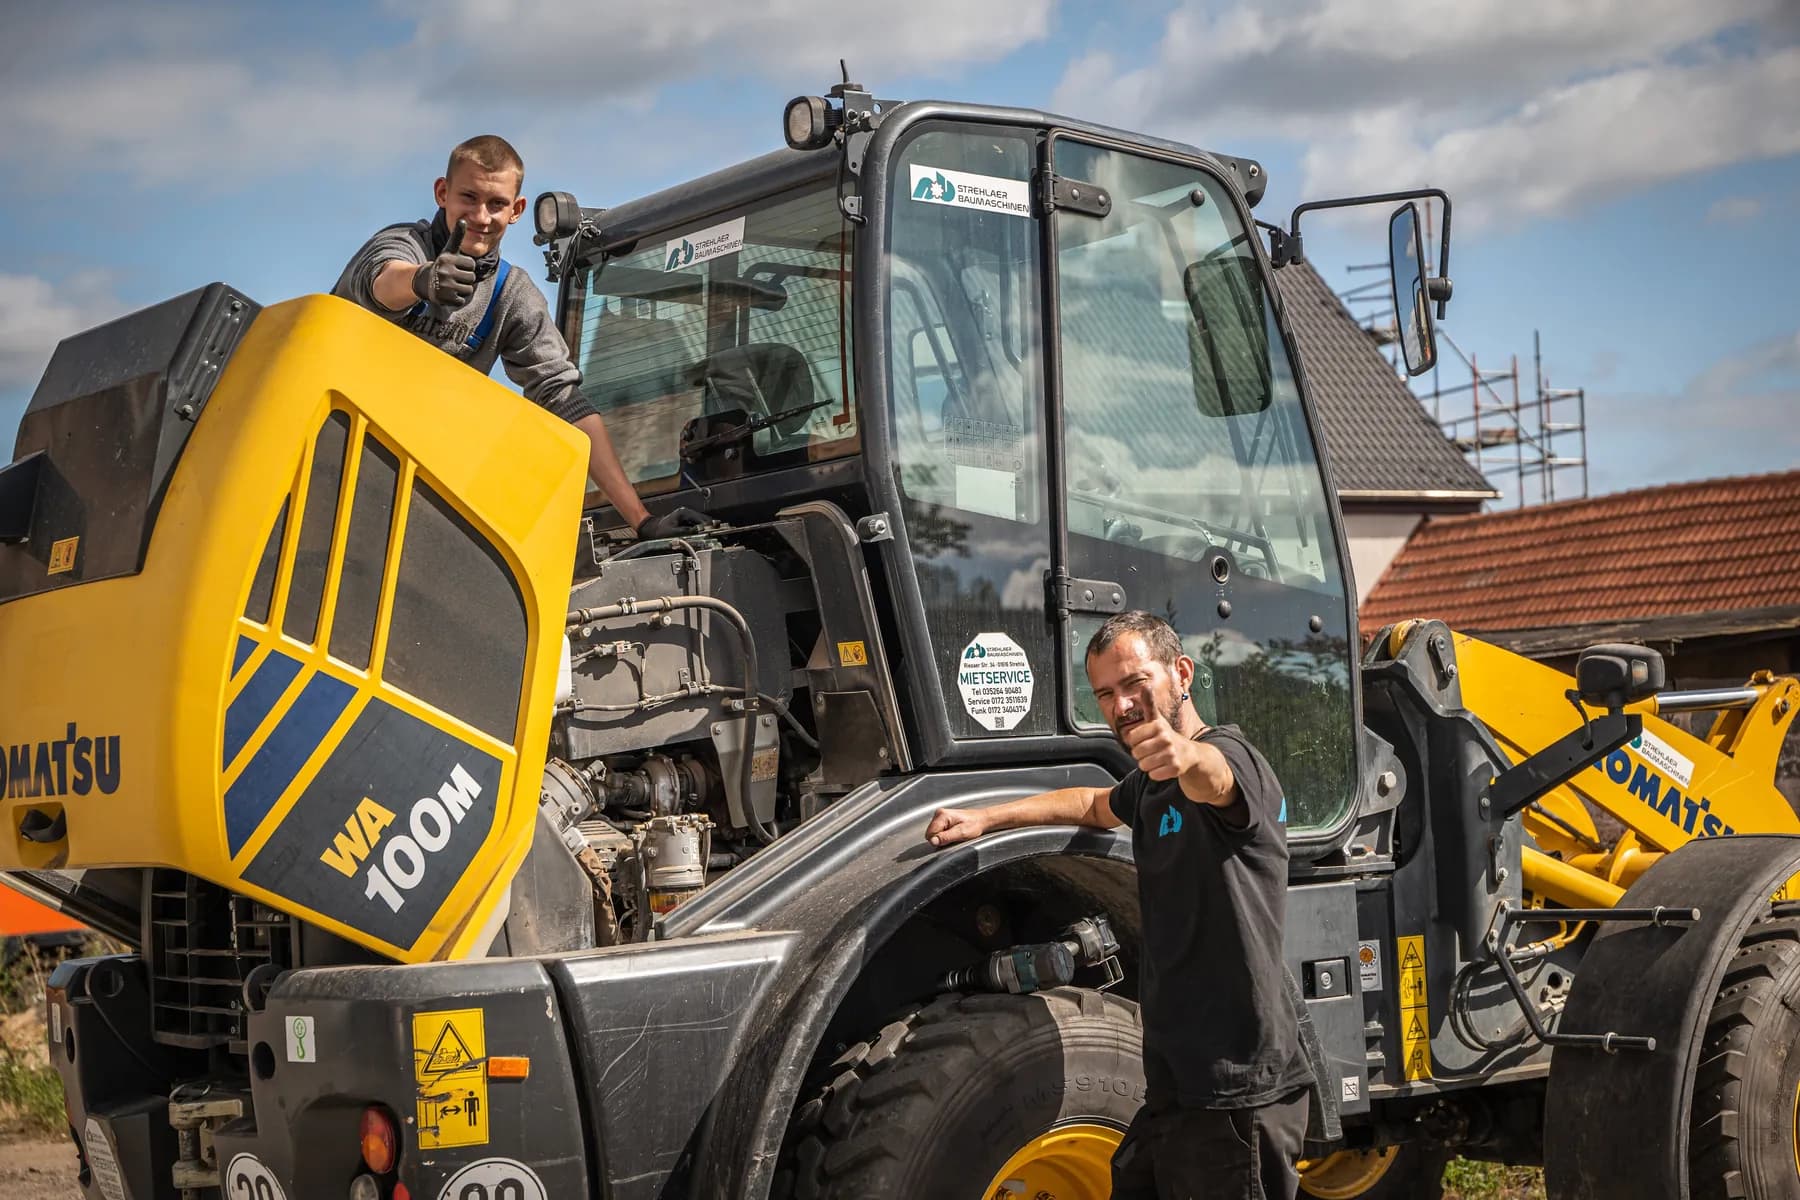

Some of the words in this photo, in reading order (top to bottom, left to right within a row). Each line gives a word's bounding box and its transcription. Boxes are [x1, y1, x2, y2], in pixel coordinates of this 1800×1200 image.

[957, 184, 1008, 199] STREHLAER
[957, 194, 1029, 213] BAUMASCHINEN
[695, 233, 730, 250] STREHLAER
[960, 670, 1031, 685] MIETSERVICE
[972, 688, 982, 696] Tel
[968, 697, 990, 706] Service
[991, 696, 1004, 705] 0172
[971, 706, 987, 715] Funk
[988, 706, 1001, 714] 0172
[1643, 739, 1678, 769] STREHLAER
[1592, 749, 1738, 837] OMATS
[319, 796, 397, 878] WA
[364, 762, 483, 914] 100M
